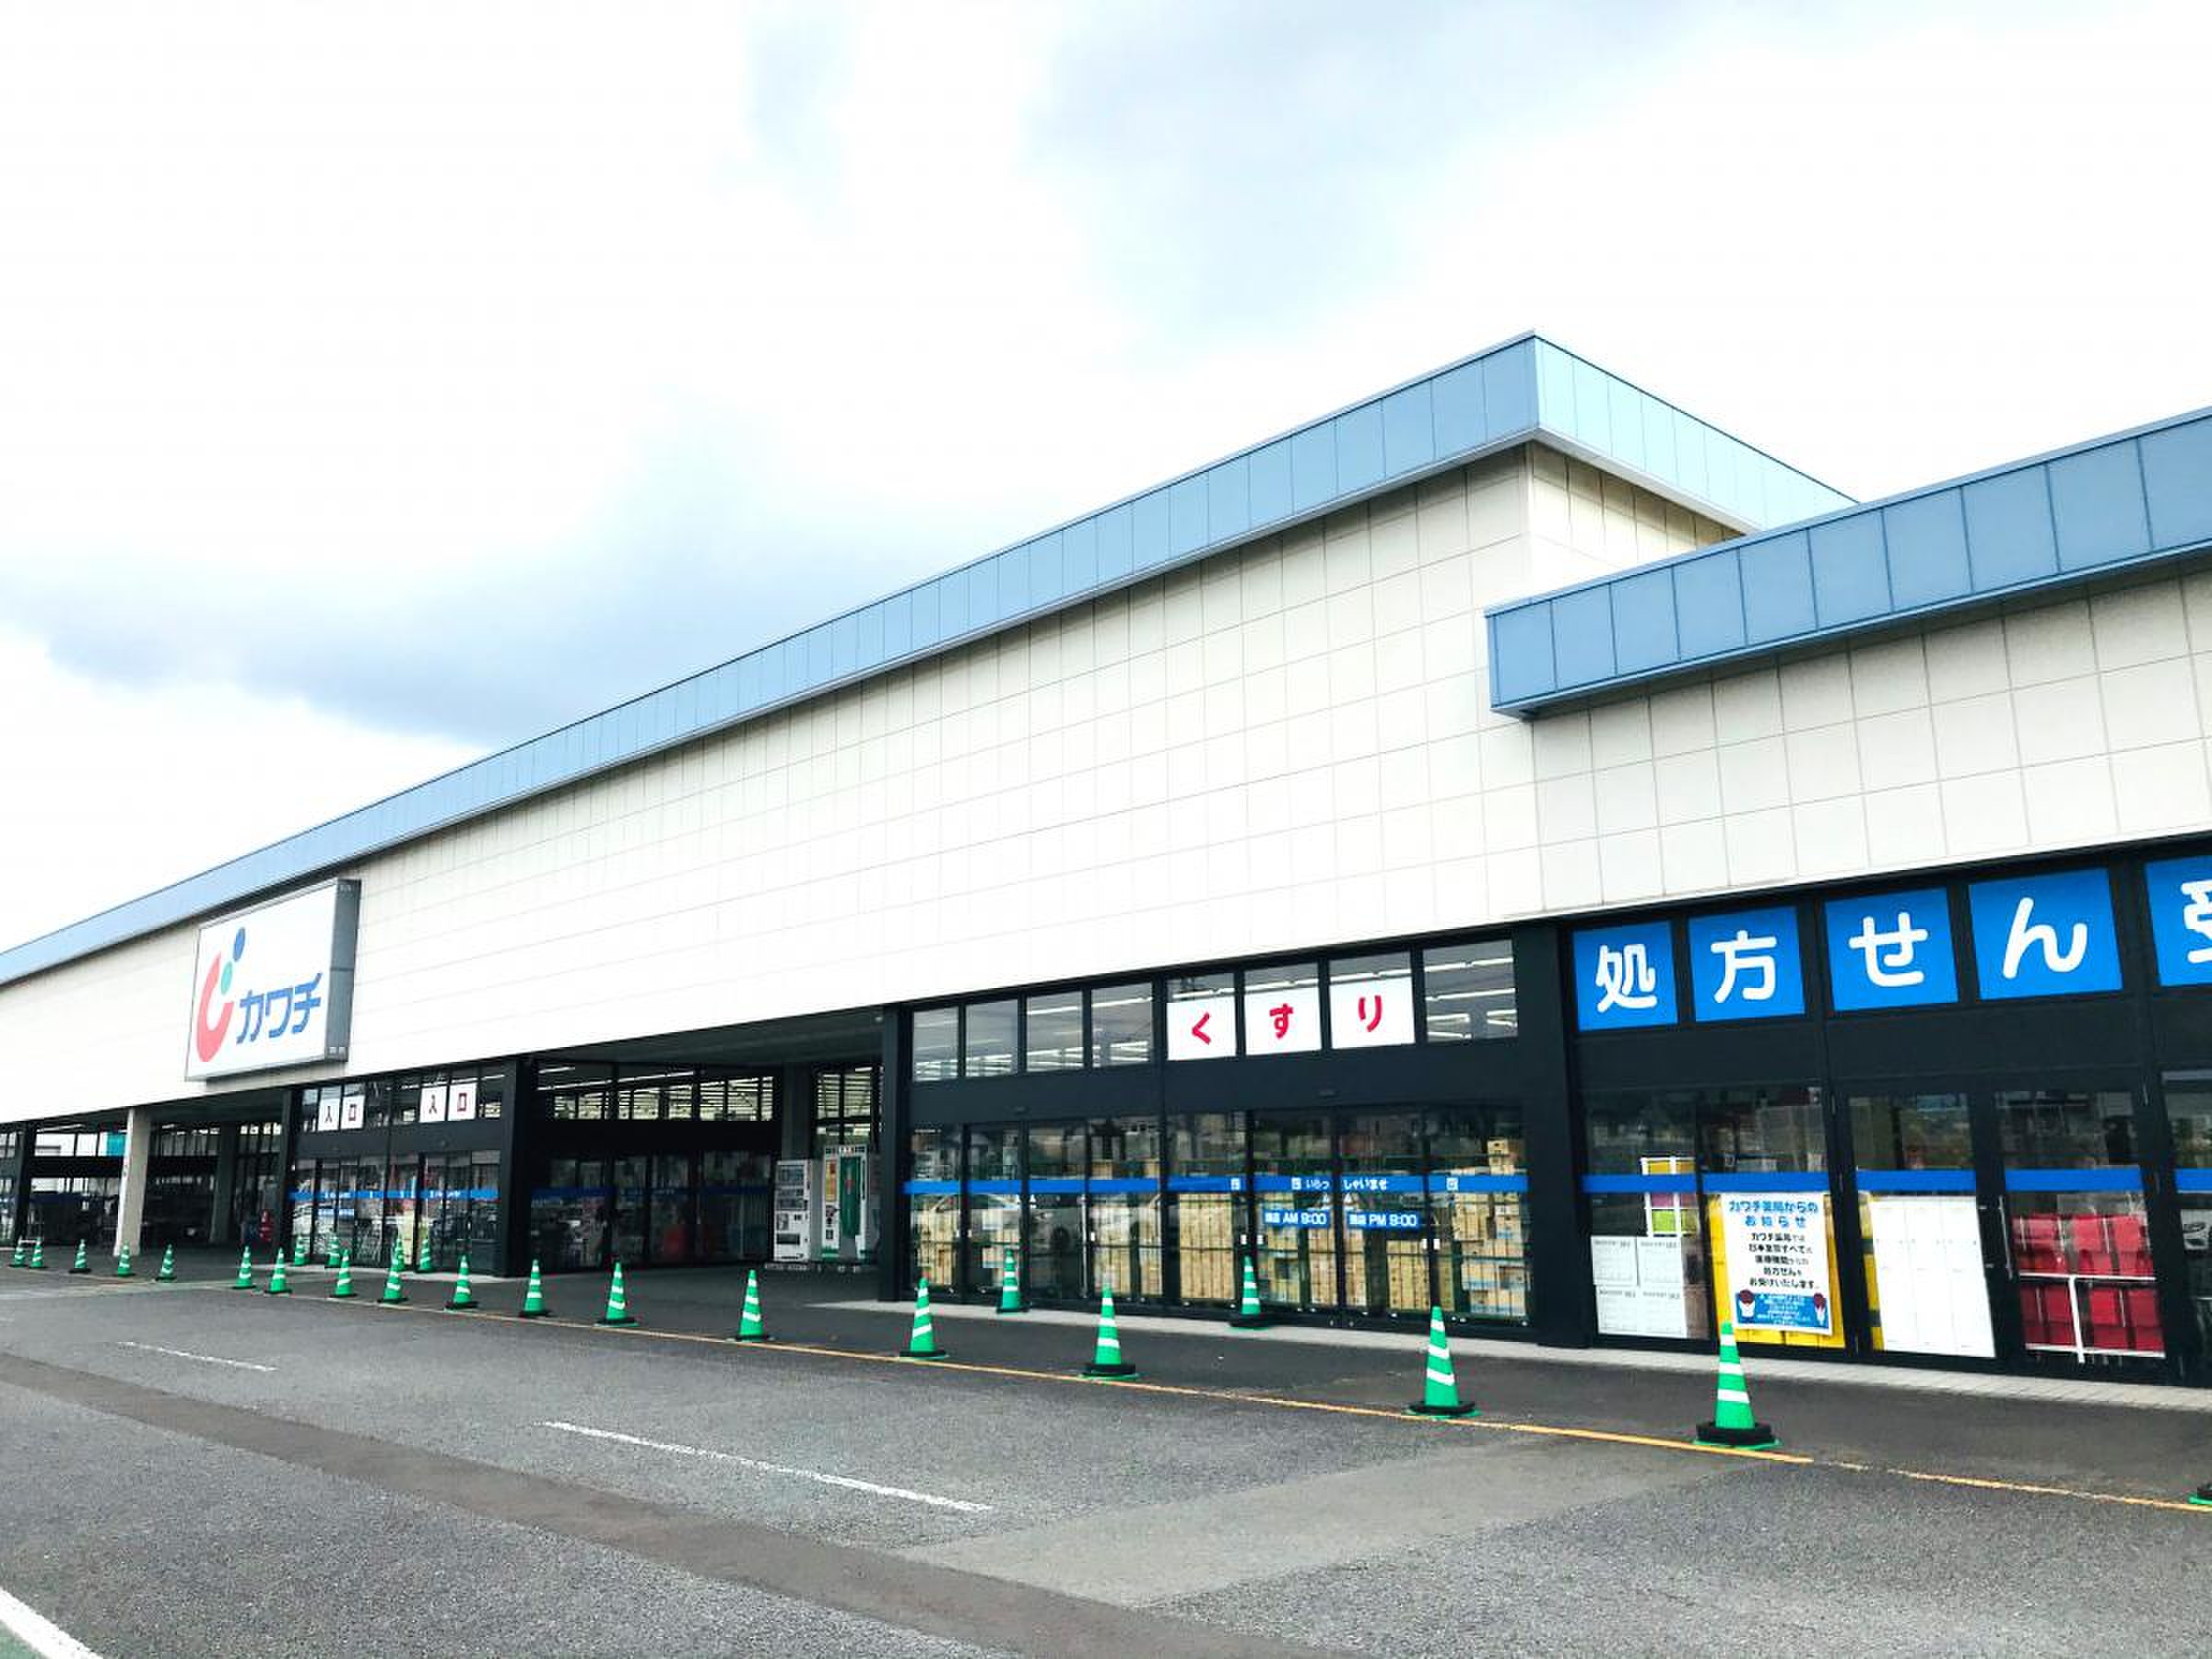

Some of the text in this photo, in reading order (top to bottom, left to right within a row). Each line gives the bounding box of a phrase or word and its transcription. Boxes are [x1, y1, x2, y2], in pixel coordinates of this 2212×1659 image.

[236, 971, 324, 1044] カワチ
[1191, 994, 1384, 1046] くすり
[324, 1103, 358, 1123] 入口
[428, 1092, 469, 1115] 入口
[1282, 1212, 1299, 1224] AM
[1369, 1214, 1386, 1226] PM
